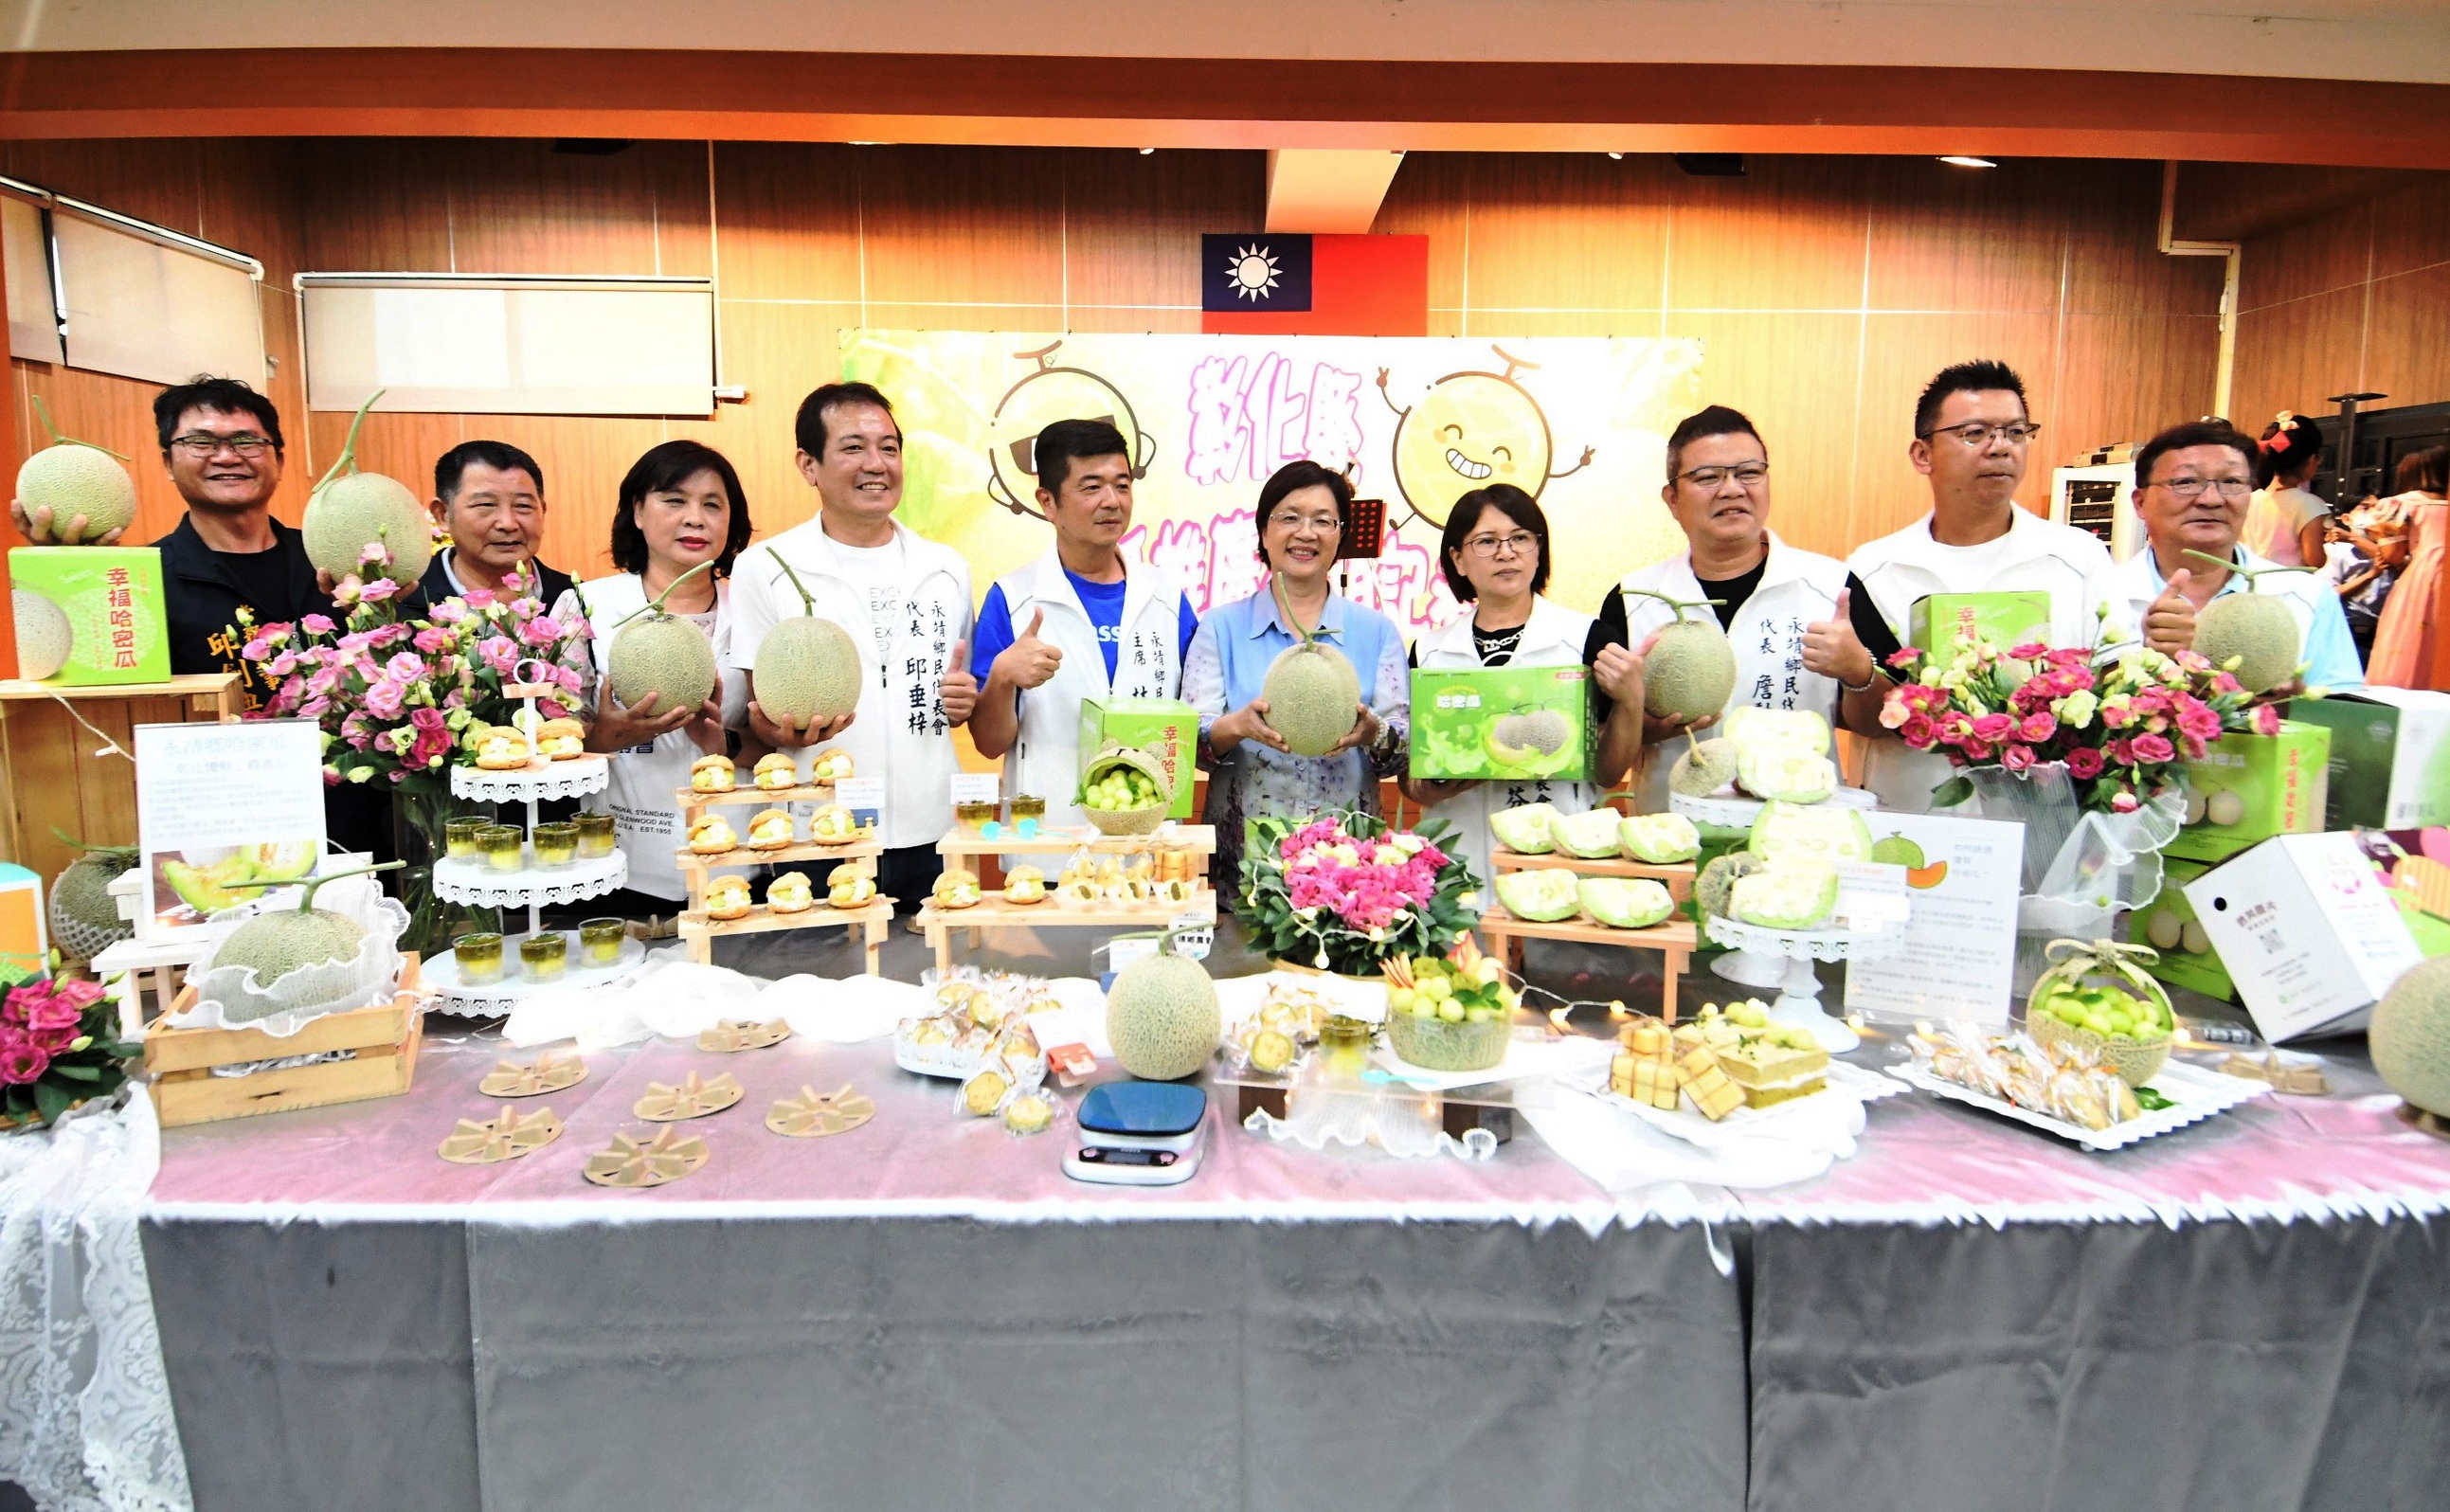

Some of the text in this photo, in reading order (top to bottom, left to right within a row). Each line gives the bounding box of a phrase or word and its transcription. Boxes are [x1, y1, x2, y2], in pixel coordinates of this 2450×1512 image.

[106, 567, 137, 668] 幸福哈密瓜
[1133, 632, 1147, 667] 主席
[1758, 619, 1777, 654] 代表
[906, 601, 928, 736] 代表 邱垂梓
[635, 809, 676, 819] STANDARD
